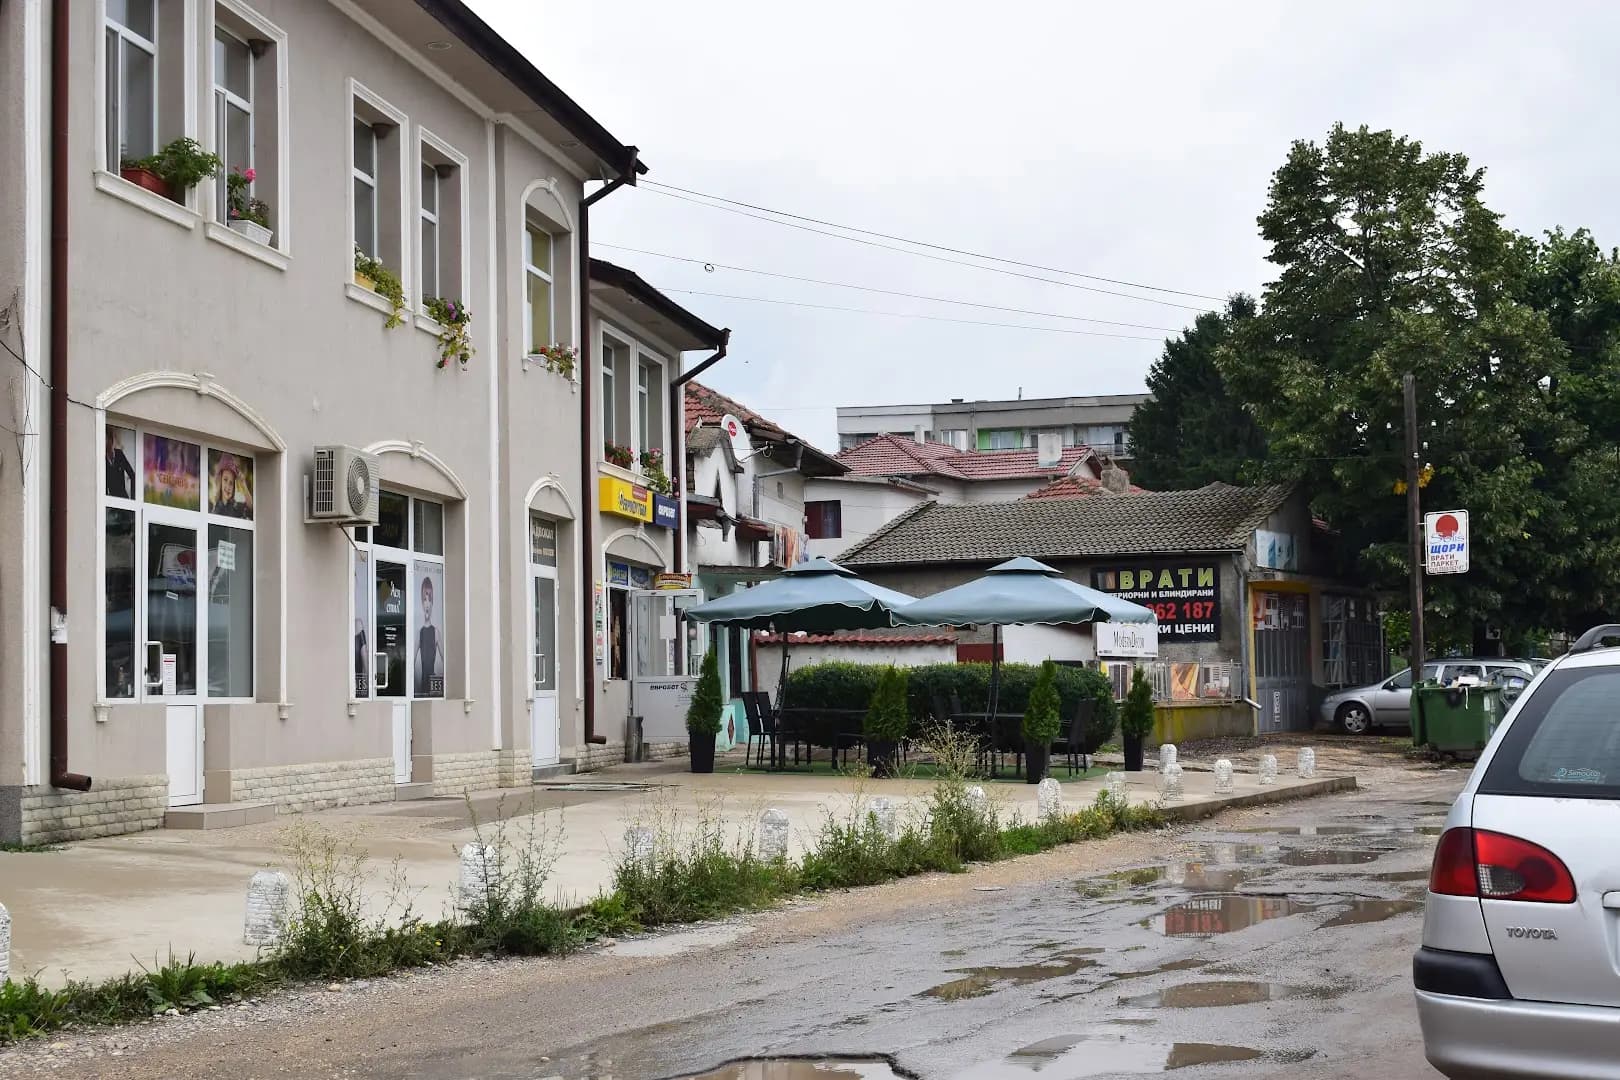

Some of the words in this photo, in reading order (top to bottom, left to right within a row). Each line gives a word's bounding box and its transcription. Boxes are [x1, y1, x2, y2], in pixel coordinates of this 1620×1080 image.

[1430, 544, 1465, 554] ЩОРИ
[1430, 553, 1455, 561] ВРАТИ
[1119, 567, 1214, 590] ВРАТИ
[1151, 591, 1158, 599] И
[1159, 589, 1214, 599] БЛИНДИРАНИ
[1183, 602, 1215, 619] 187
[1175, 623, 1215, 635] ЦЕНИ!
[1506, 927, 1558, 940] TOYOTA
